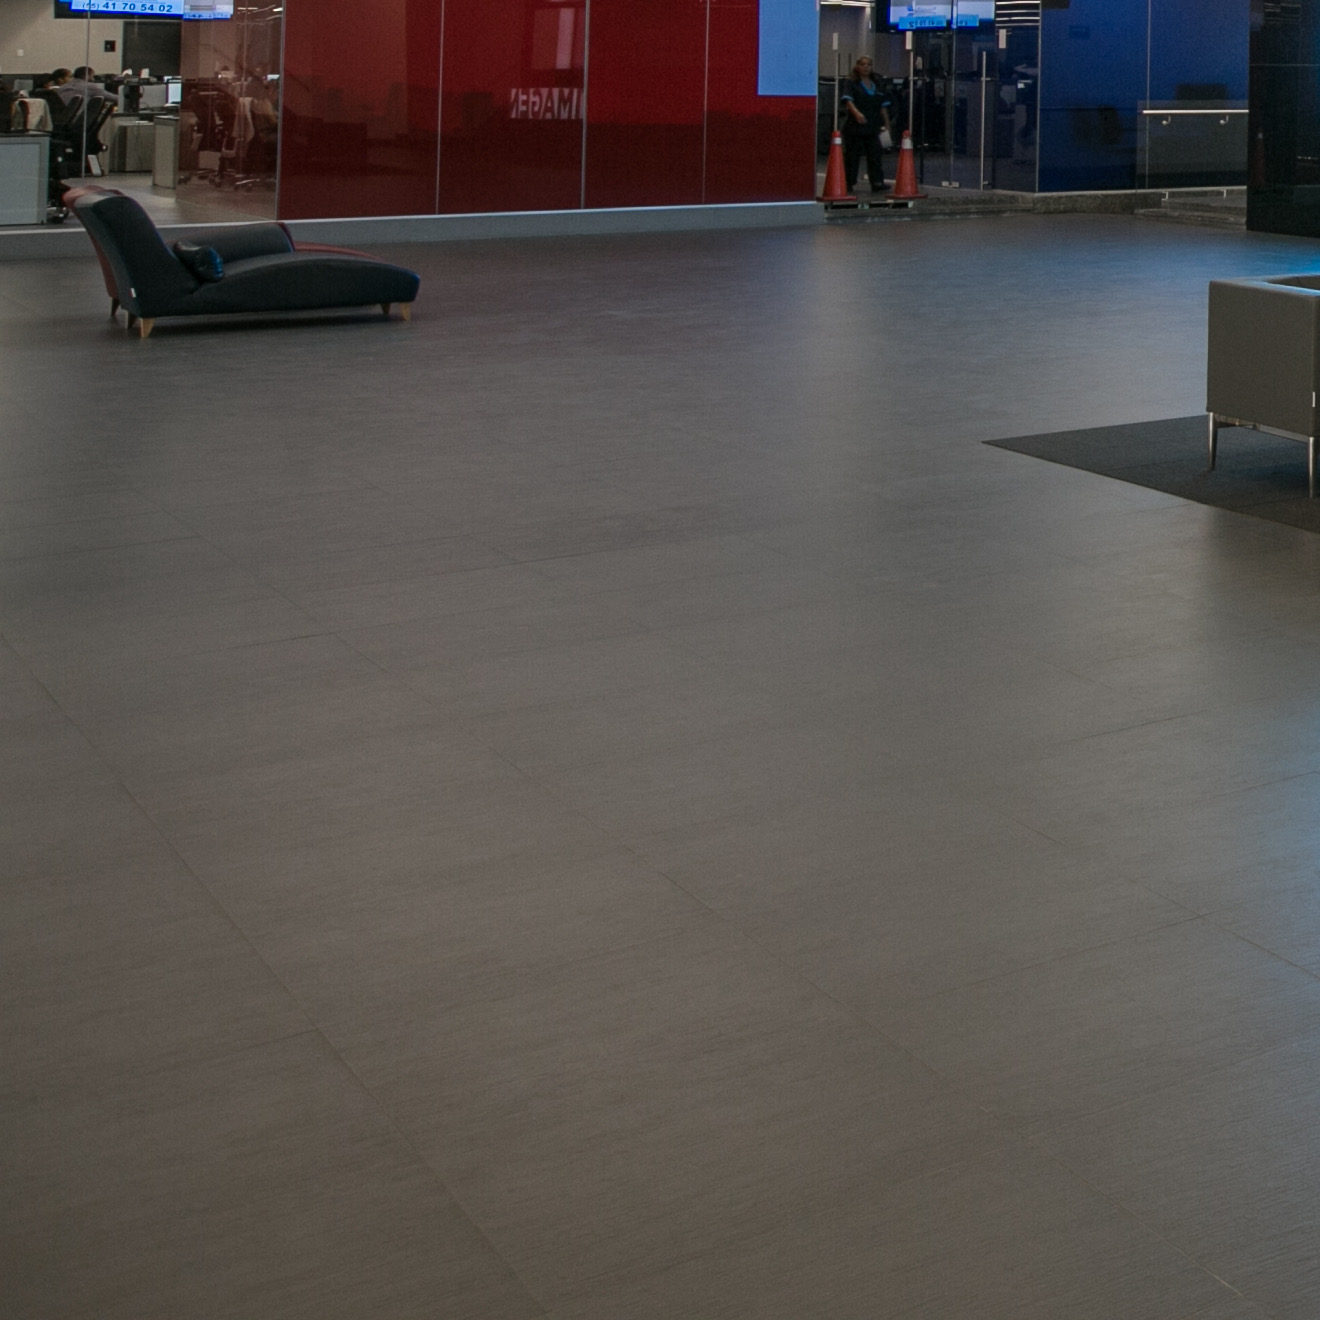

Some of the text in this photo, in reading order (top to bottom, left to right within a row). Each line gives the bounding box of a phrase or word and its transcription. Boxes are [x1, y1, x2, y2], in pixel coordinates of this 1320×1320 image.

[102, 2, 116, 10] 41
[122, 3, 136, 11] 70
[140, 4, 154, 12] 54
[158, 4, 173, 13] 02
